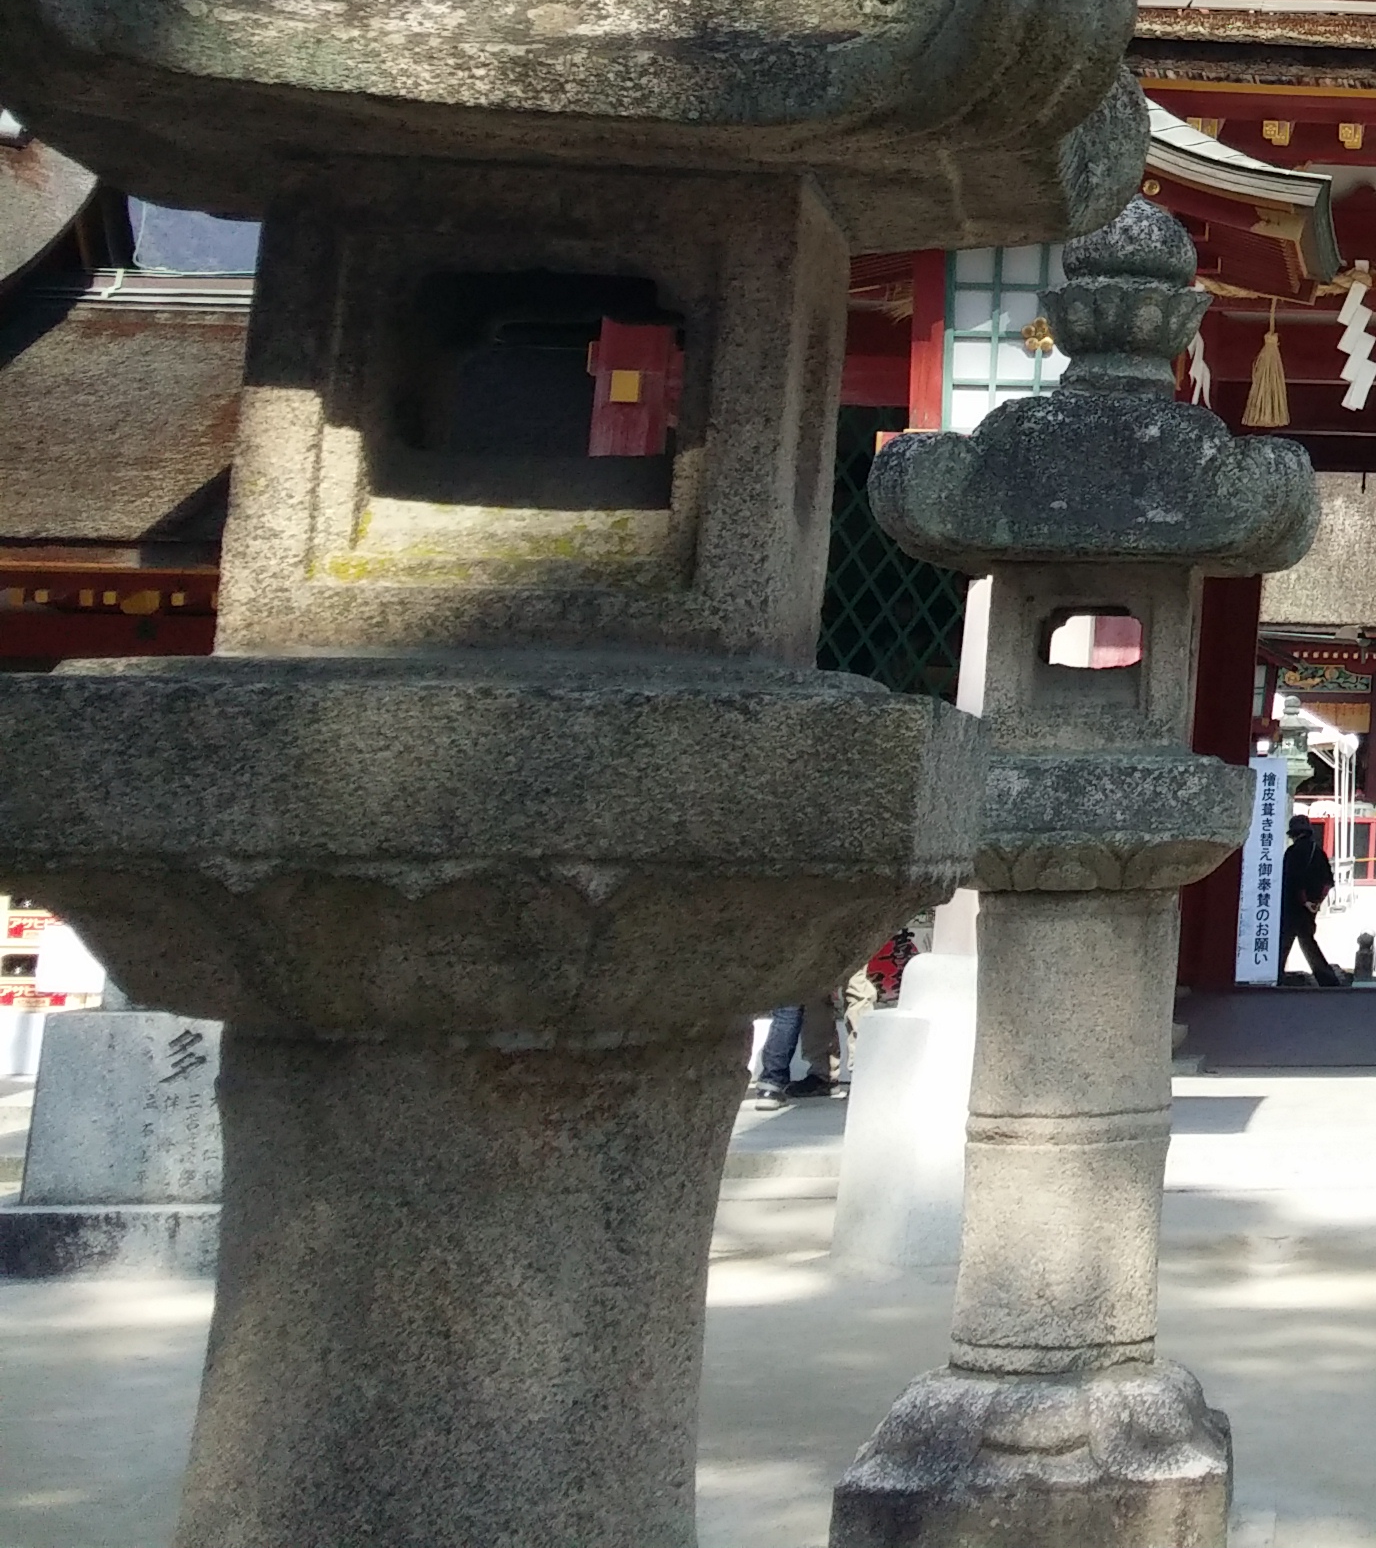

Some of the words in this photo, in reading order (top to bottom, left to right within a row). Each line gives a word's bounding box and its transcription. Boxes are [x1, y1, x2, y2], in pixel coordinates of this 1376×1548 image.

[1253, 771, 1277, 966] 檜皮葺き替え御奉賛のお願い
[159, 1030, 207, 1084] 多
